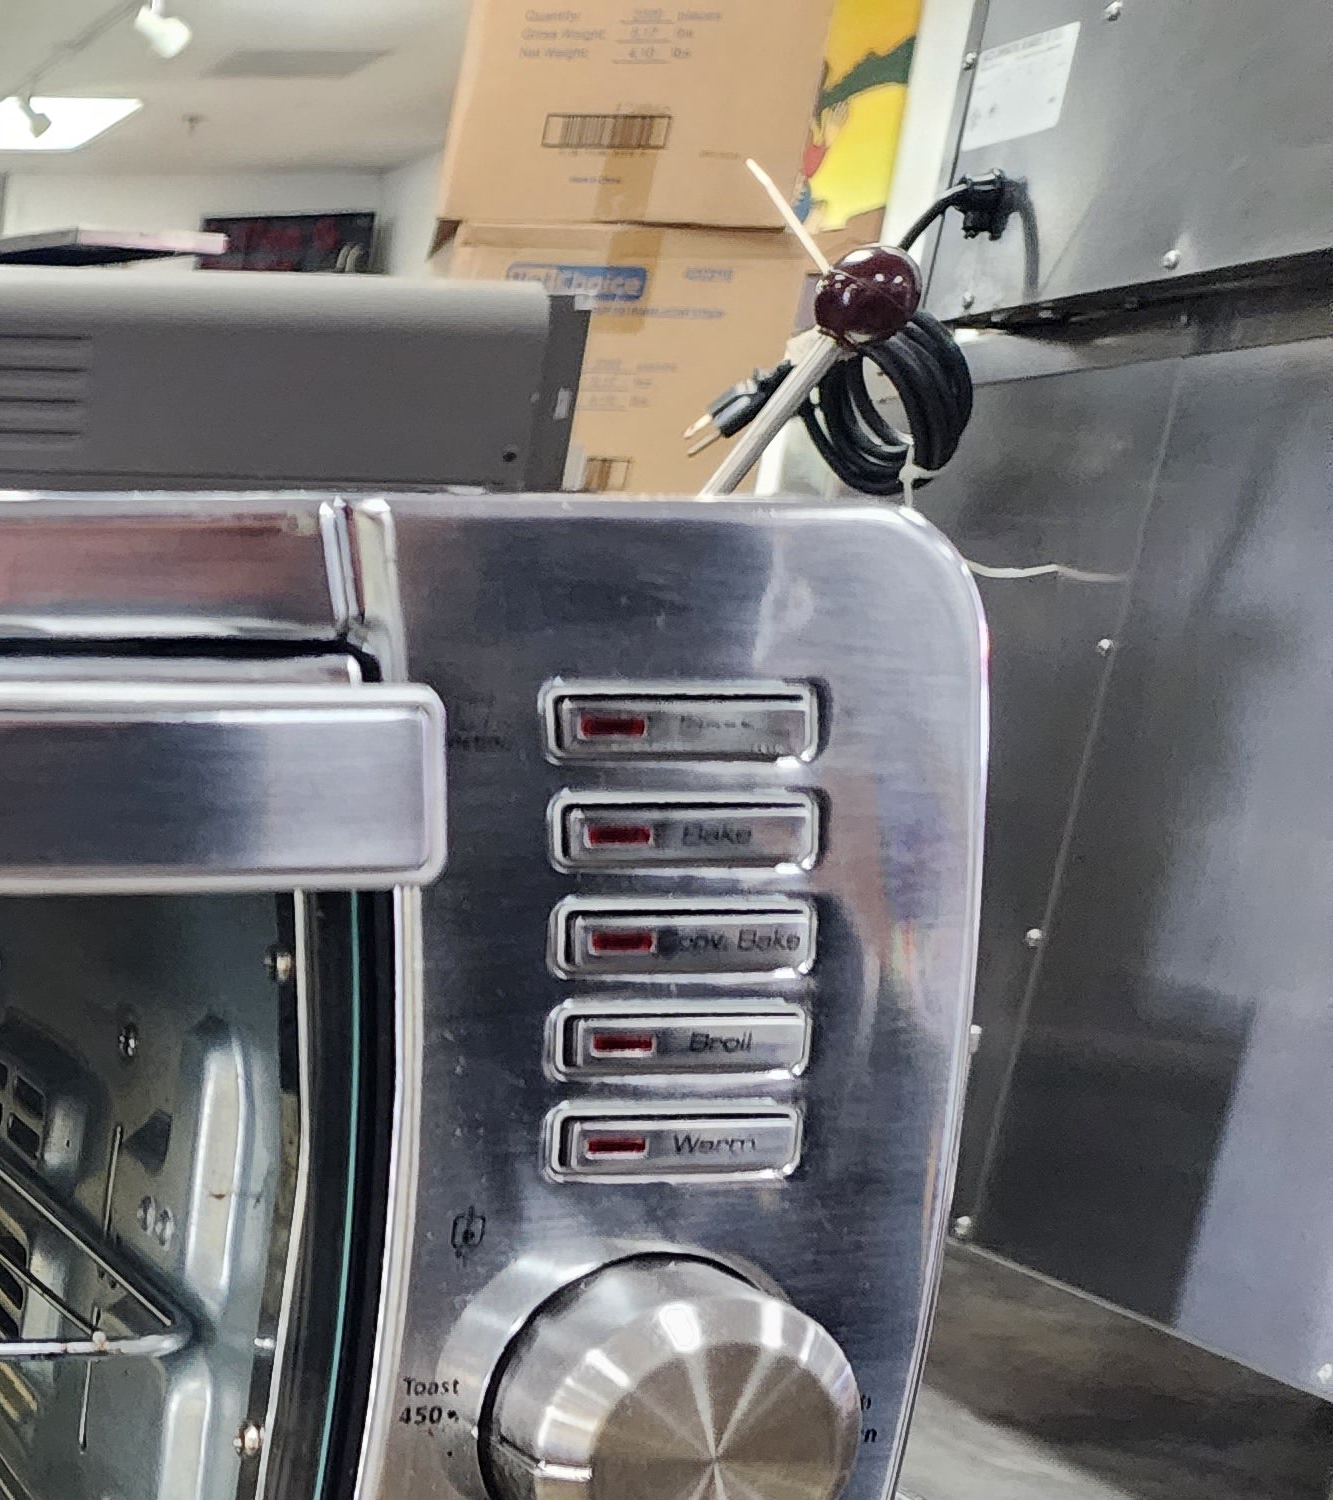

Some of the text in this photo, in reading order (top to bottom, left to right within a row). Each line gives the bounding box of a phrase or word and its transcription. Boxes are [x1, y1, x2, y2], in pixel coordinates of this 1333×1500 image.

[737, 928, 801, 952] Bake
[689, 1028, 754, 1054] Broil
[673, 1132, 758, 1155] Warm
[403, 1376, 460, 1397] Toast
[399, 1405, 443, 1426] 450
